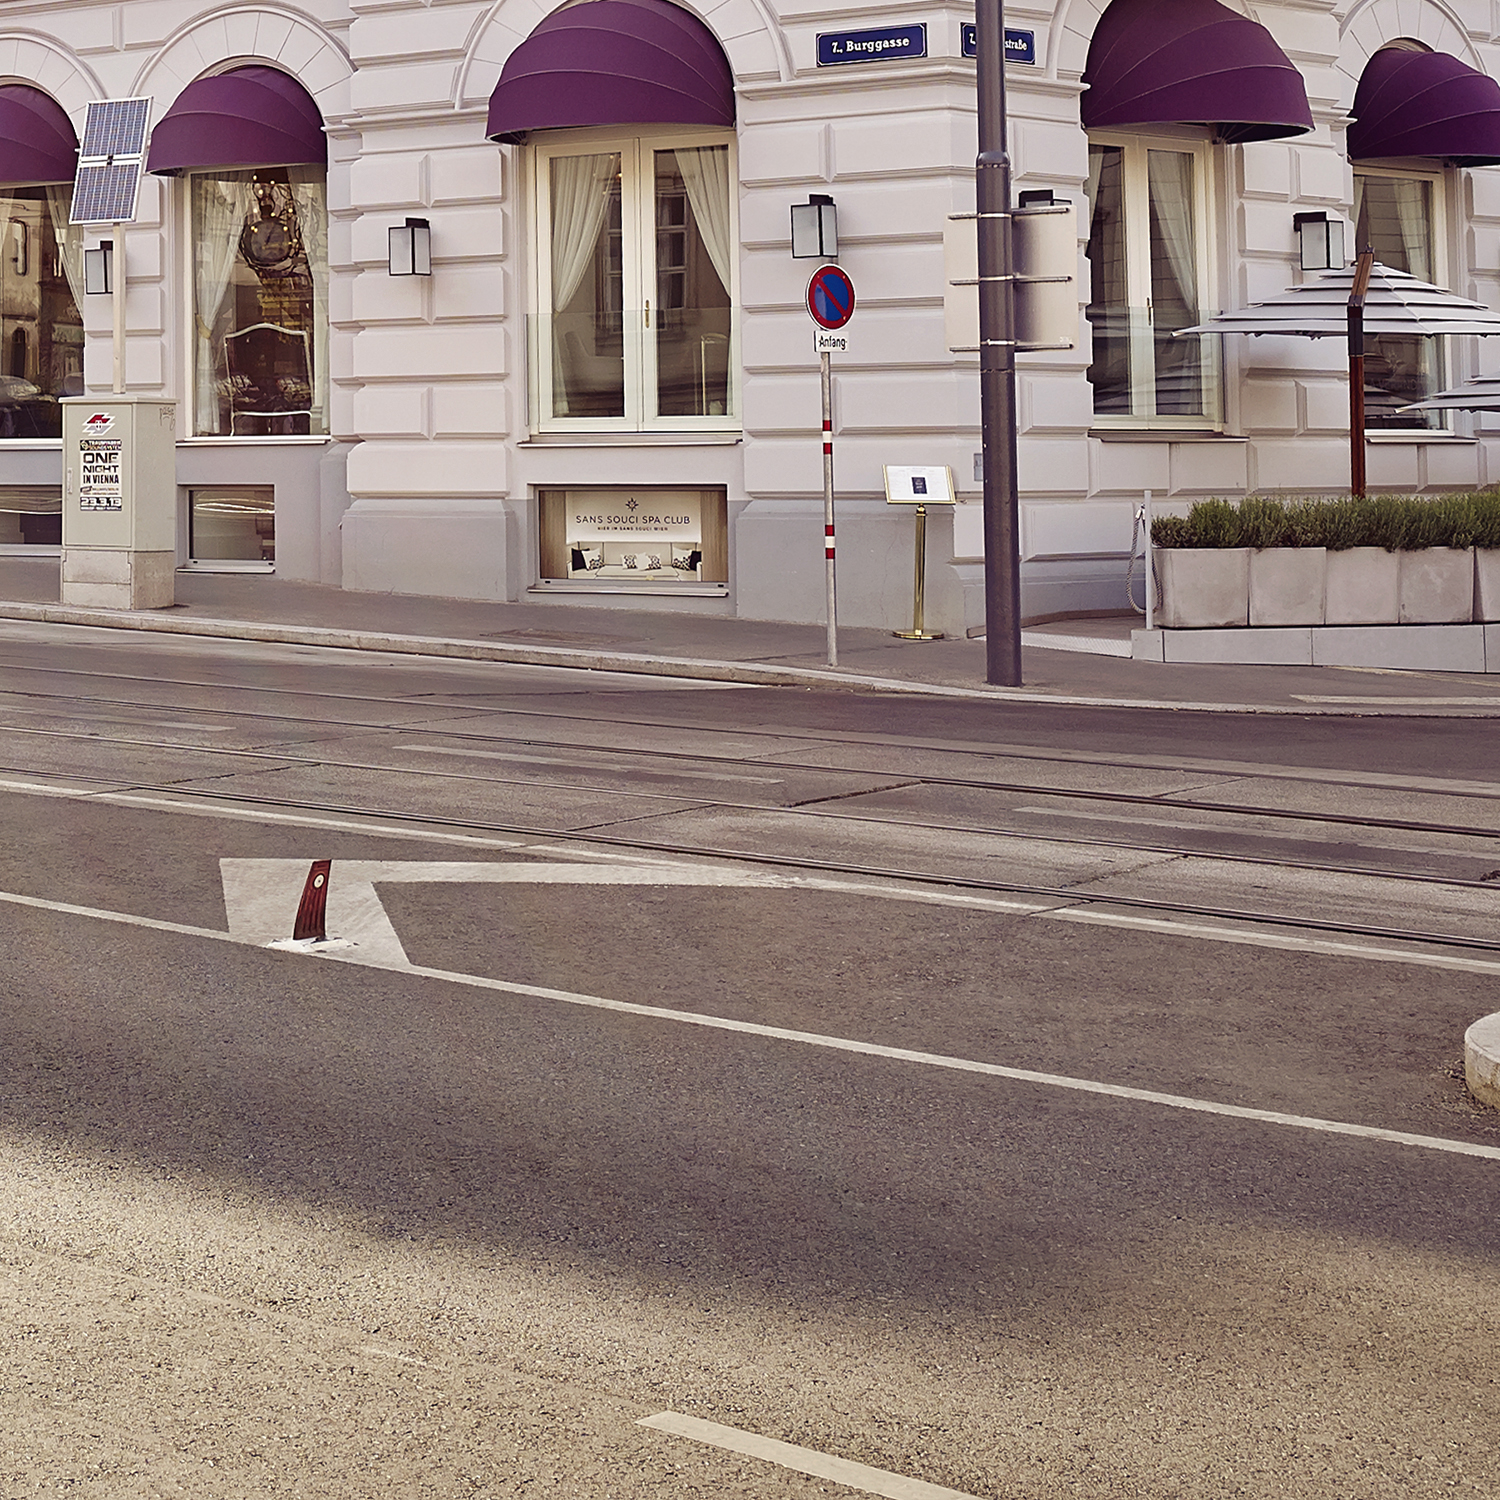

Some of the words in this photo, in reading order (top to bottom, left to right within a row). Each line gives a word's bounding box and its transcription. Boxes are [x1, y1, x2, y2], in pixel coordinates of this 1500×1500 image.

[846, 37, 910, 53] Burggasse
[819, 335, 847, 351] Anfang
[83, 452, 119, 464] ONE
[83, 465, 120, 474] NIGHT
[83, 474, 91, 484] IN
[92, 474, 120, 484] VIENNA
[575, 515, 604, 524] SANS
[606, 515, 639, 525] SOUCI
[642, 515, 661, 525] SPA
[663, 515, 691, 525] CLUB
